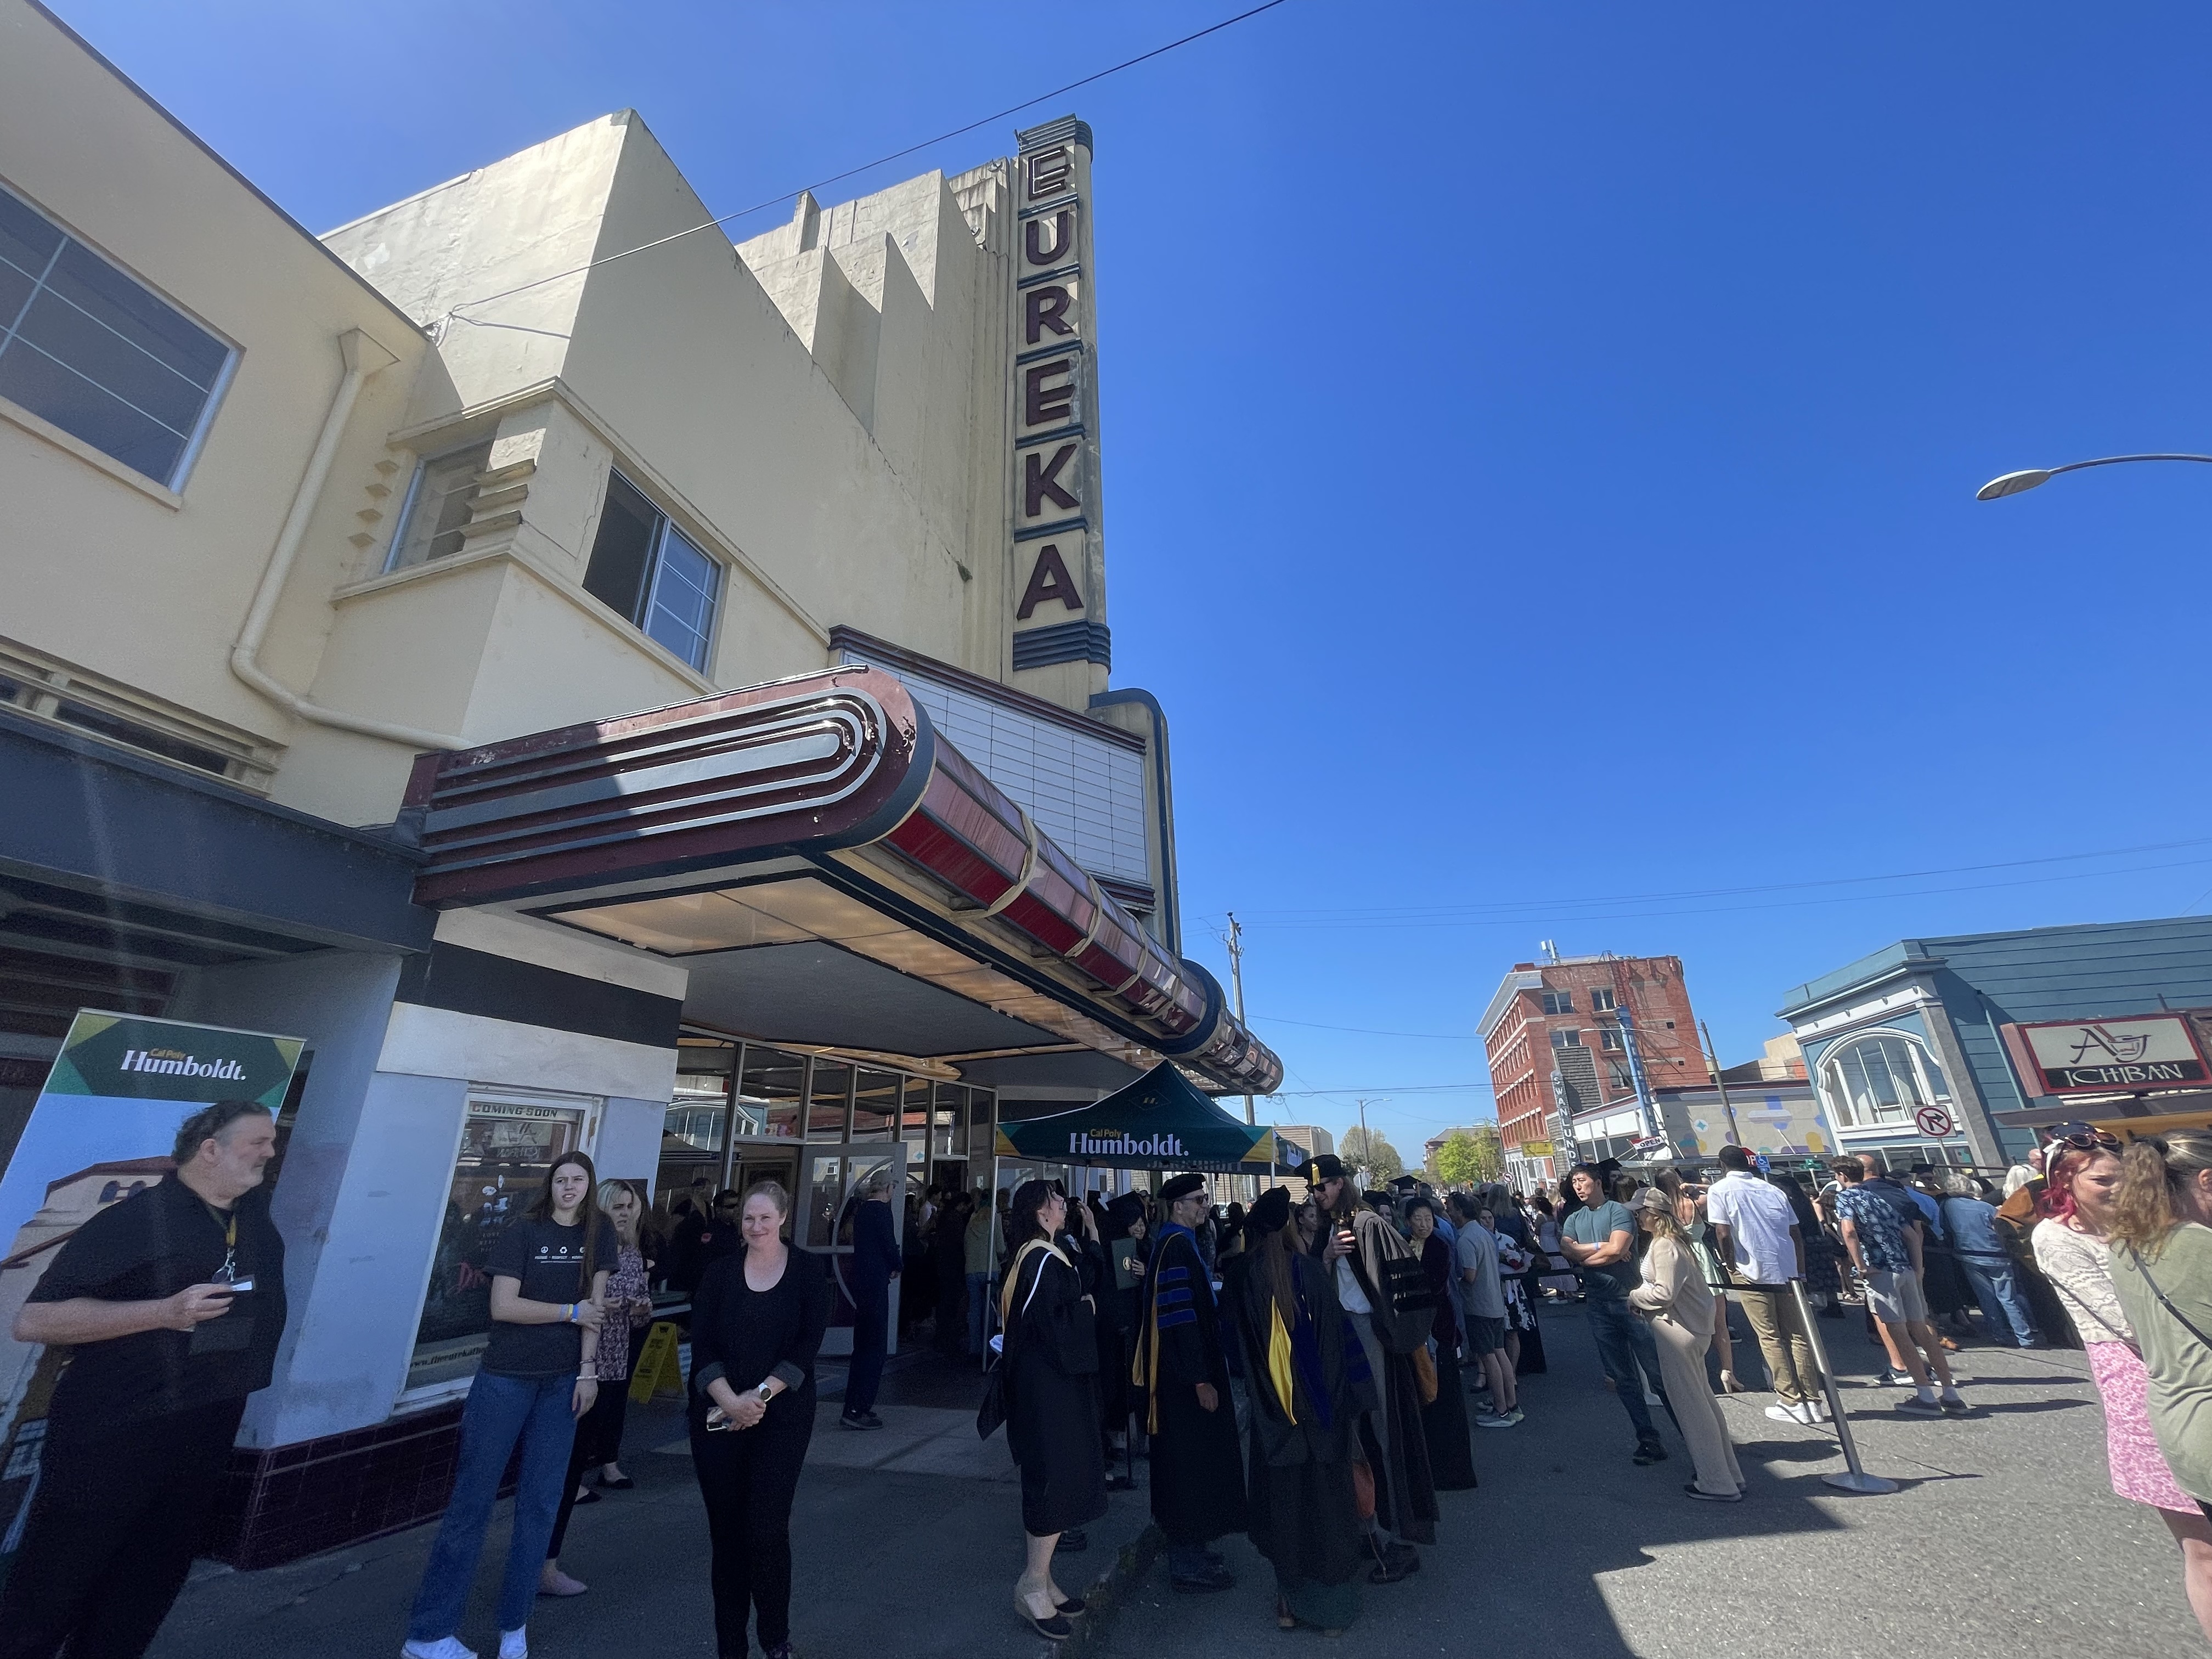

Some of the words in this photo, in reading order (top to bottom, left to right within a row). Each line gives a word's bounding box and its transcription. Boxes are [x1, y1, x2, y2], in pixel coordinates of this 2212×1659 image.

[1017, 145, 1084, 621] EUREKA
[150, 1048, 166, 1057] Cal
[166, 1049, 187, 1060] Poly
[120, 1049, 246, 1081] Humboldt.
[2064, 1064, 2185, 1087] ICHIBAN
[471, 1104, 523, 1116] COMING
[526, 1107, 558, 1118] SOON
[1090, 1128, 1103, 1137] Cal
[1104, 1129, 1121, 1139] Poly
[1640, 1138, 1661, 1147] OPEN
[1070, 1132, 1189, 1156] Humboldt.
